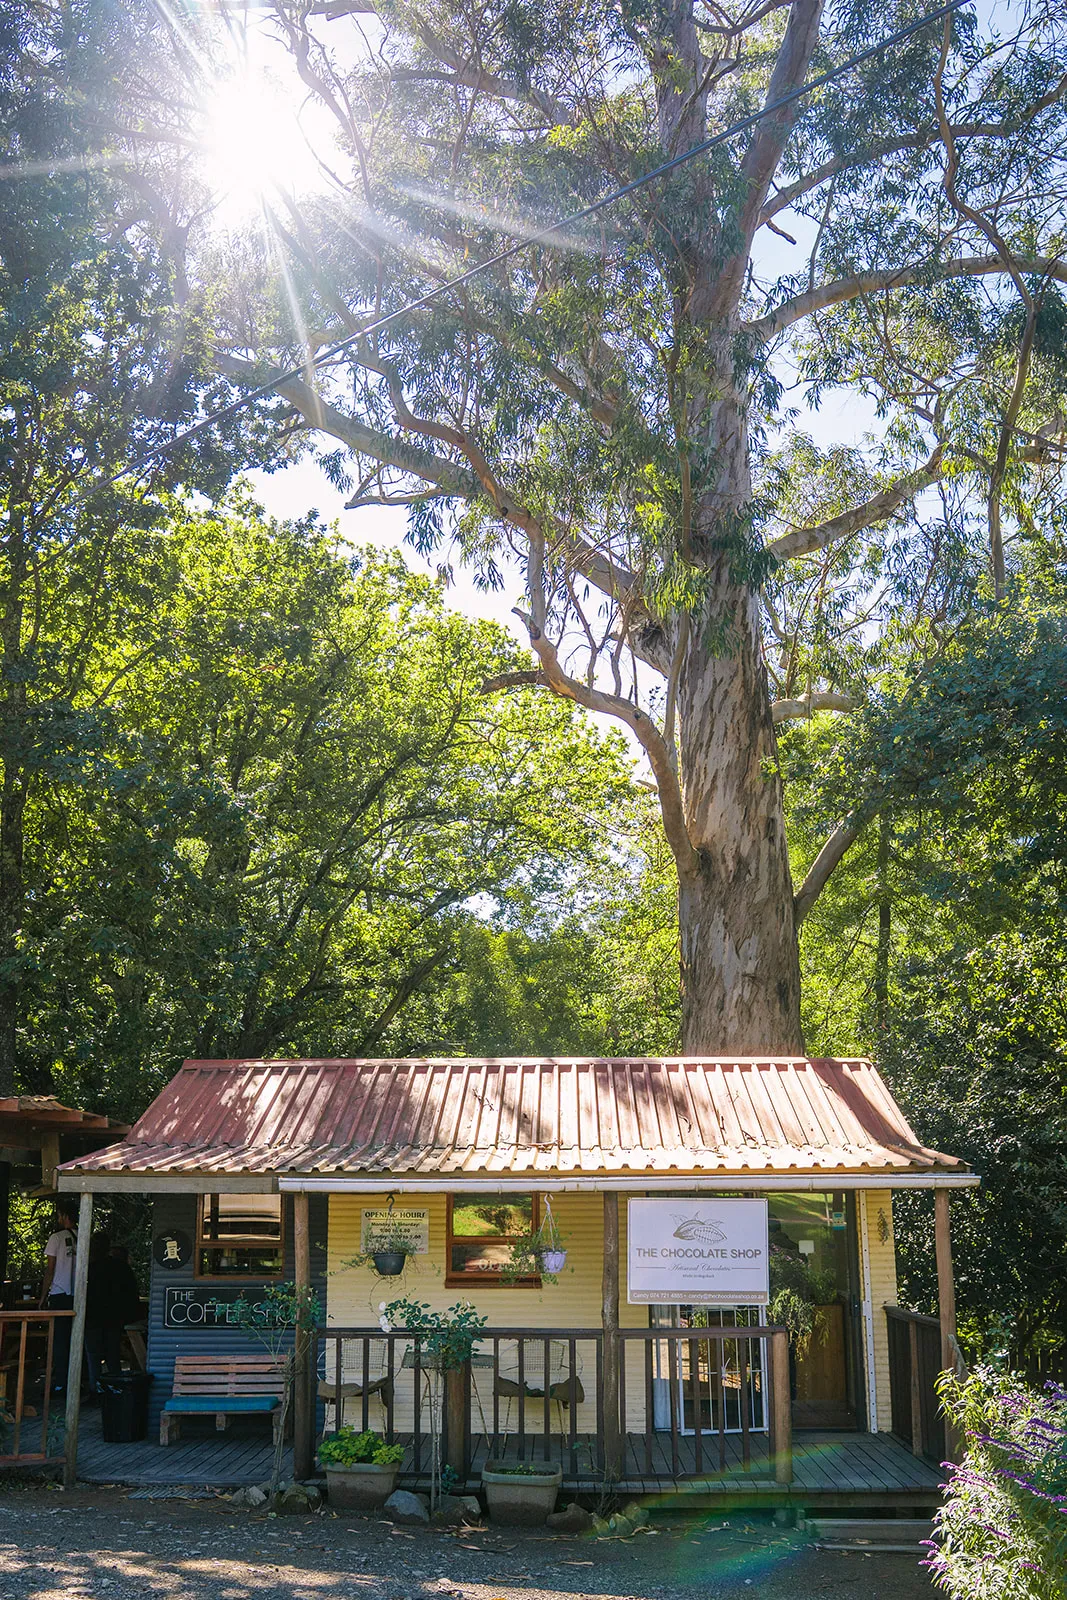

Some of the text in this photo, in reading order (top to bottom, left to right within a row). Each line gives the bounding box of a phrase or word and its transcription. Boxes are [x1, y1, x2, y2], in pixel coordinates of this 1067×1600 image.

[636, 1247, 762, 1259] THE CHOCOLATE SHOP
[172, 1290, 195, 1302] THE
[170, 1302, 250, 1324] COFFEE
